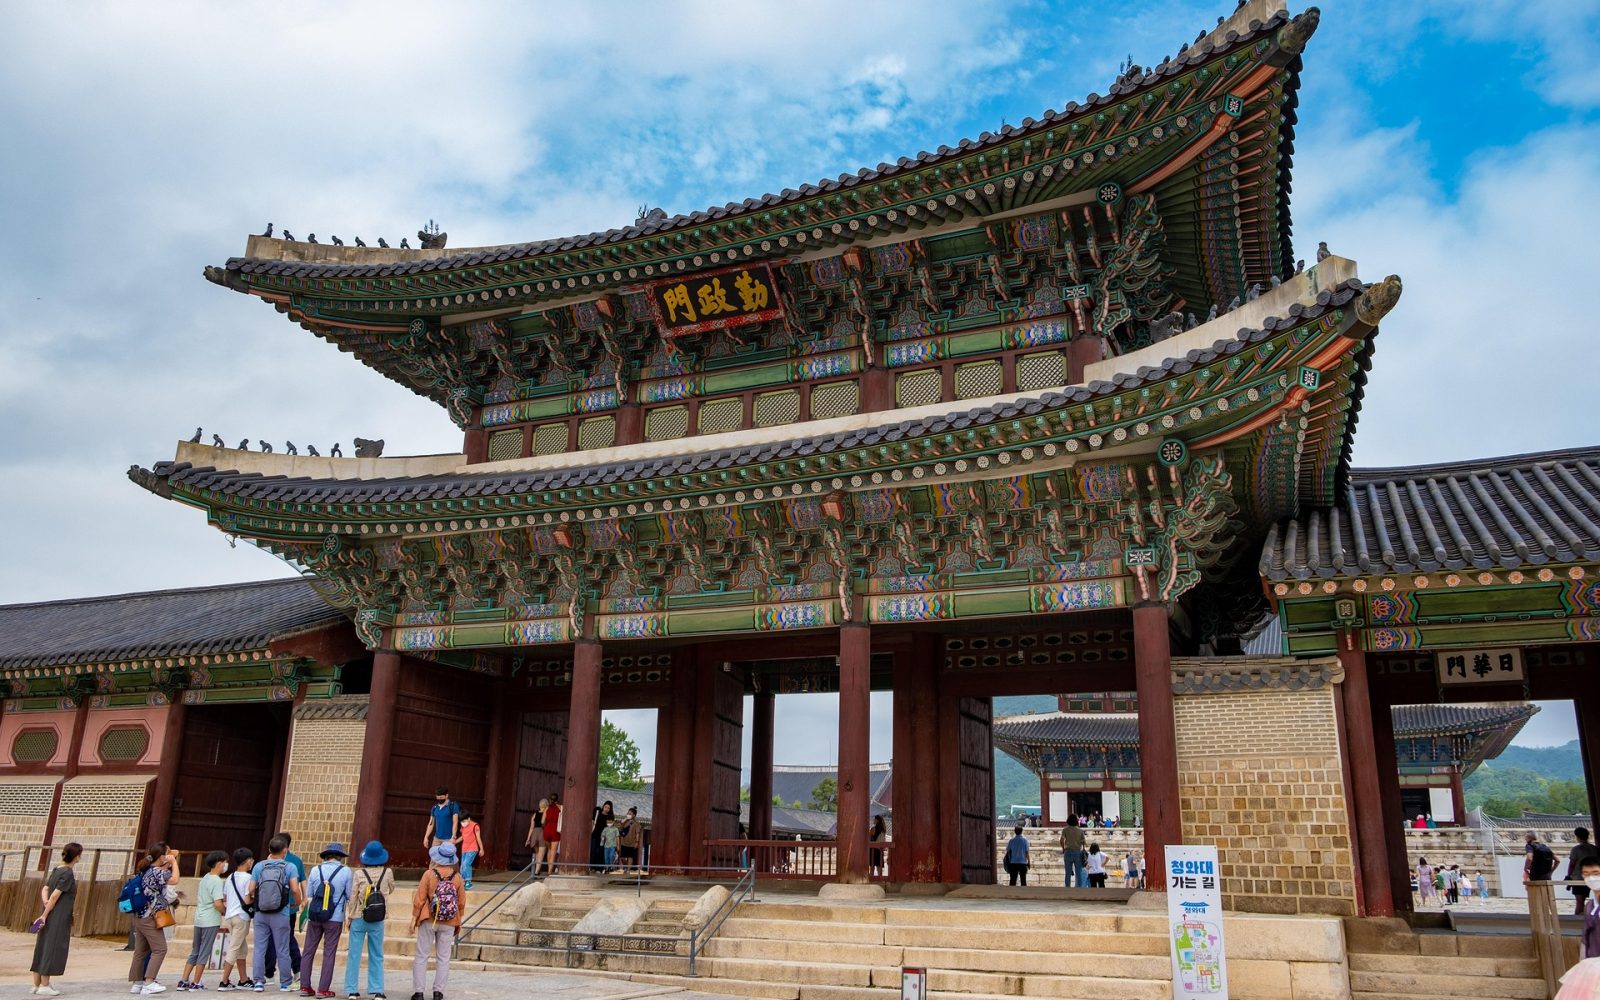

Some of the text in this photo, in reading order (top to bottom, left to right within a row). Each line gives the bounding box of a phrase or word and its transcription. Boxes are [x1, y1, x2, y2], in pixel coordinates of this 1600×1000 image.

[1171, 860, 1213, 875] 청와대
[1171, 876, 1215, 889] 가는 길
